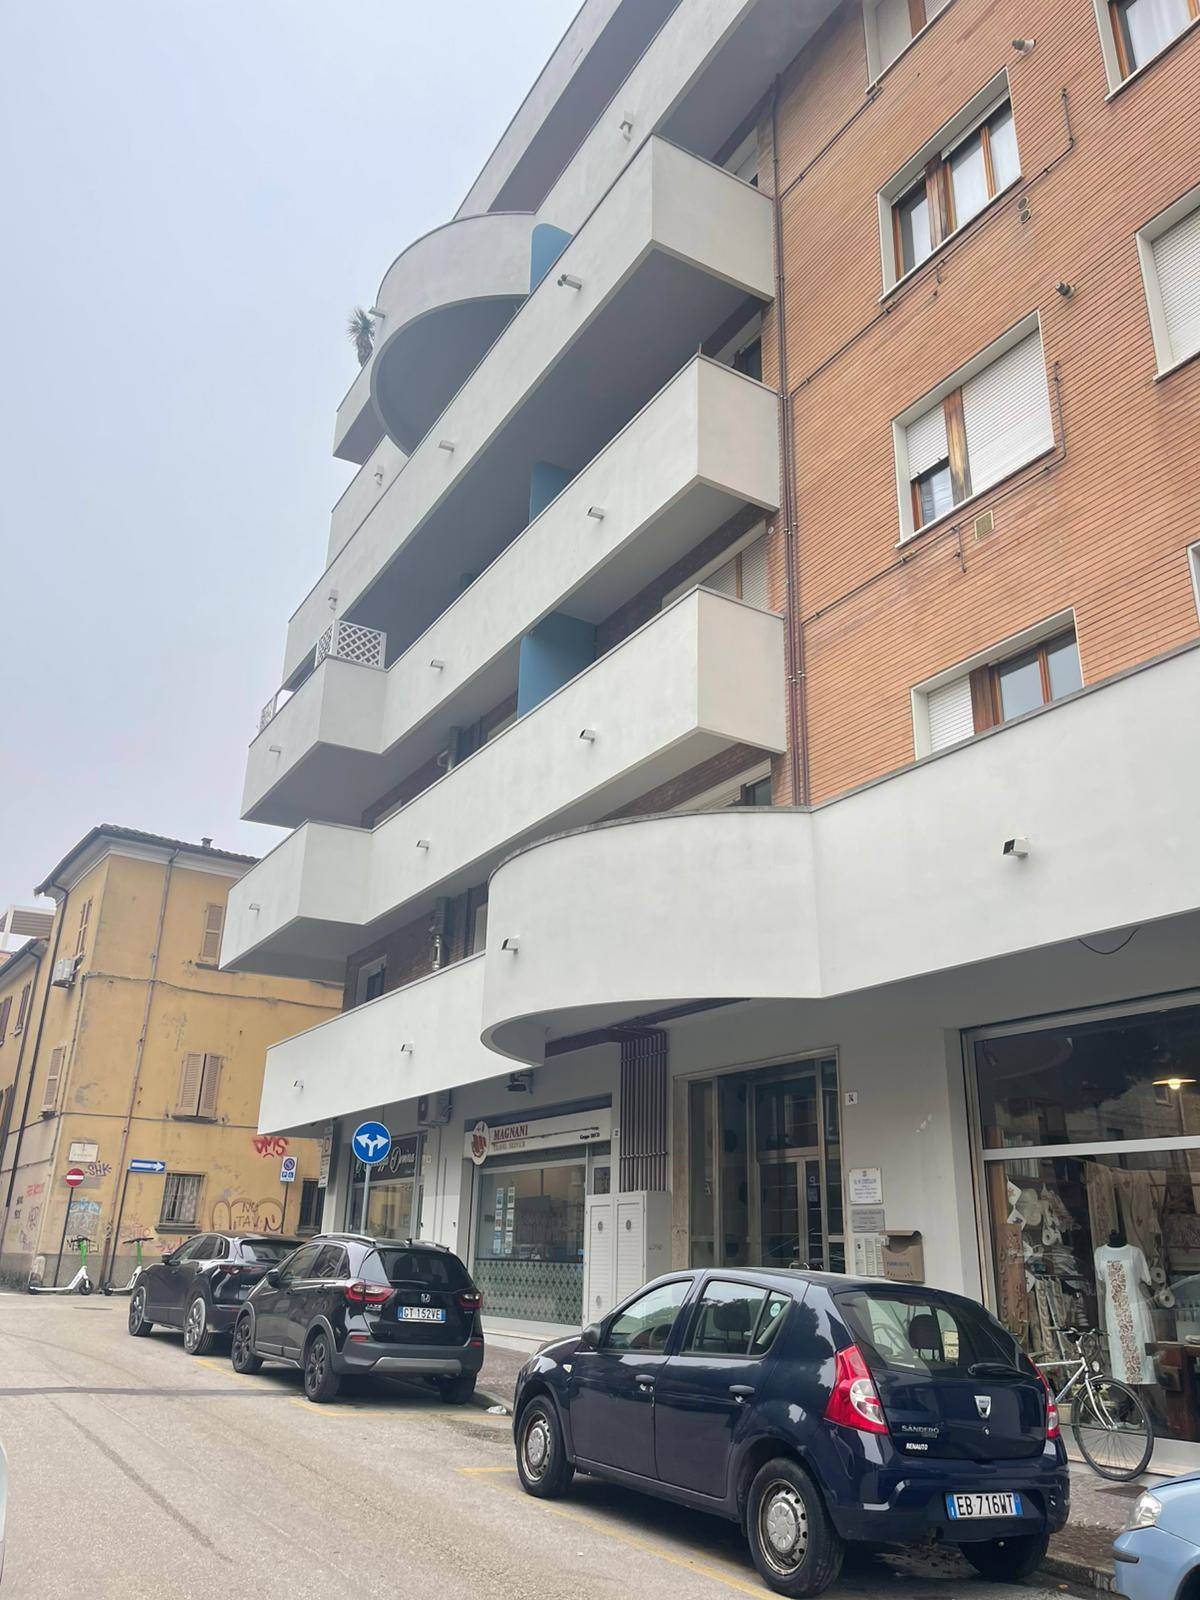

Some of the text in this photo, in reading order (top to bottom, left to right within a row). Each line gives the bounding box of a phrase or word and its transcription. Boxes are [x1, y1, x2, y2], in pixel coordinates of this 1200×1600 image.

[493, 1124, 529, 1141] MAGNANI
[901, 1424, 940, 1434] SANDERO
[956, 1494, 1014, 1516] EB 716WT
